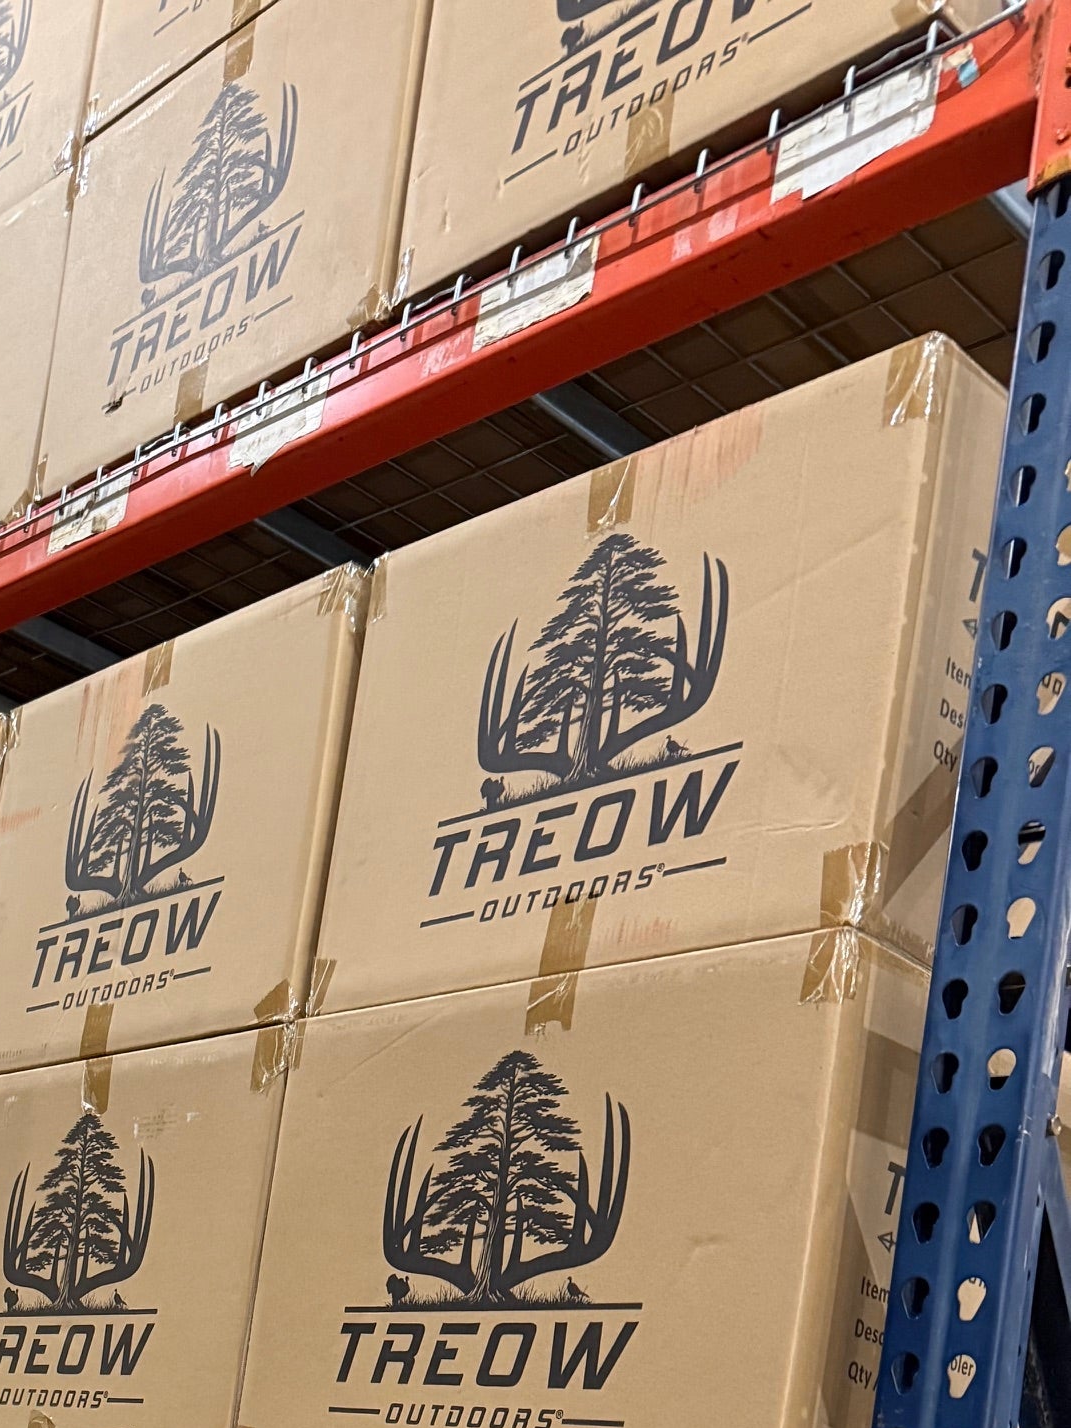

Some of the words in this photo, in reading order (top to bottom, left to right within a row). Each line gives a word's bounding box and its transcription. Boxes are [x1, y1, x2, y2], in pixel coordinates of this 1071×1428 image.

[563, 37, 741, 155] OUTDOORS
[107, 225, 302, 386] TREOW
[429, 759, 740, 897] TREOW
[479, 863, 657, 922] OUTDOORS
[32, 890, 222, 989] TREOW
[62, 969, 170, 1011] OUTDOORS
[336, 1321, 639, 1390] TREOW
[0, 1388, 104, 1409] OUTDOORS
